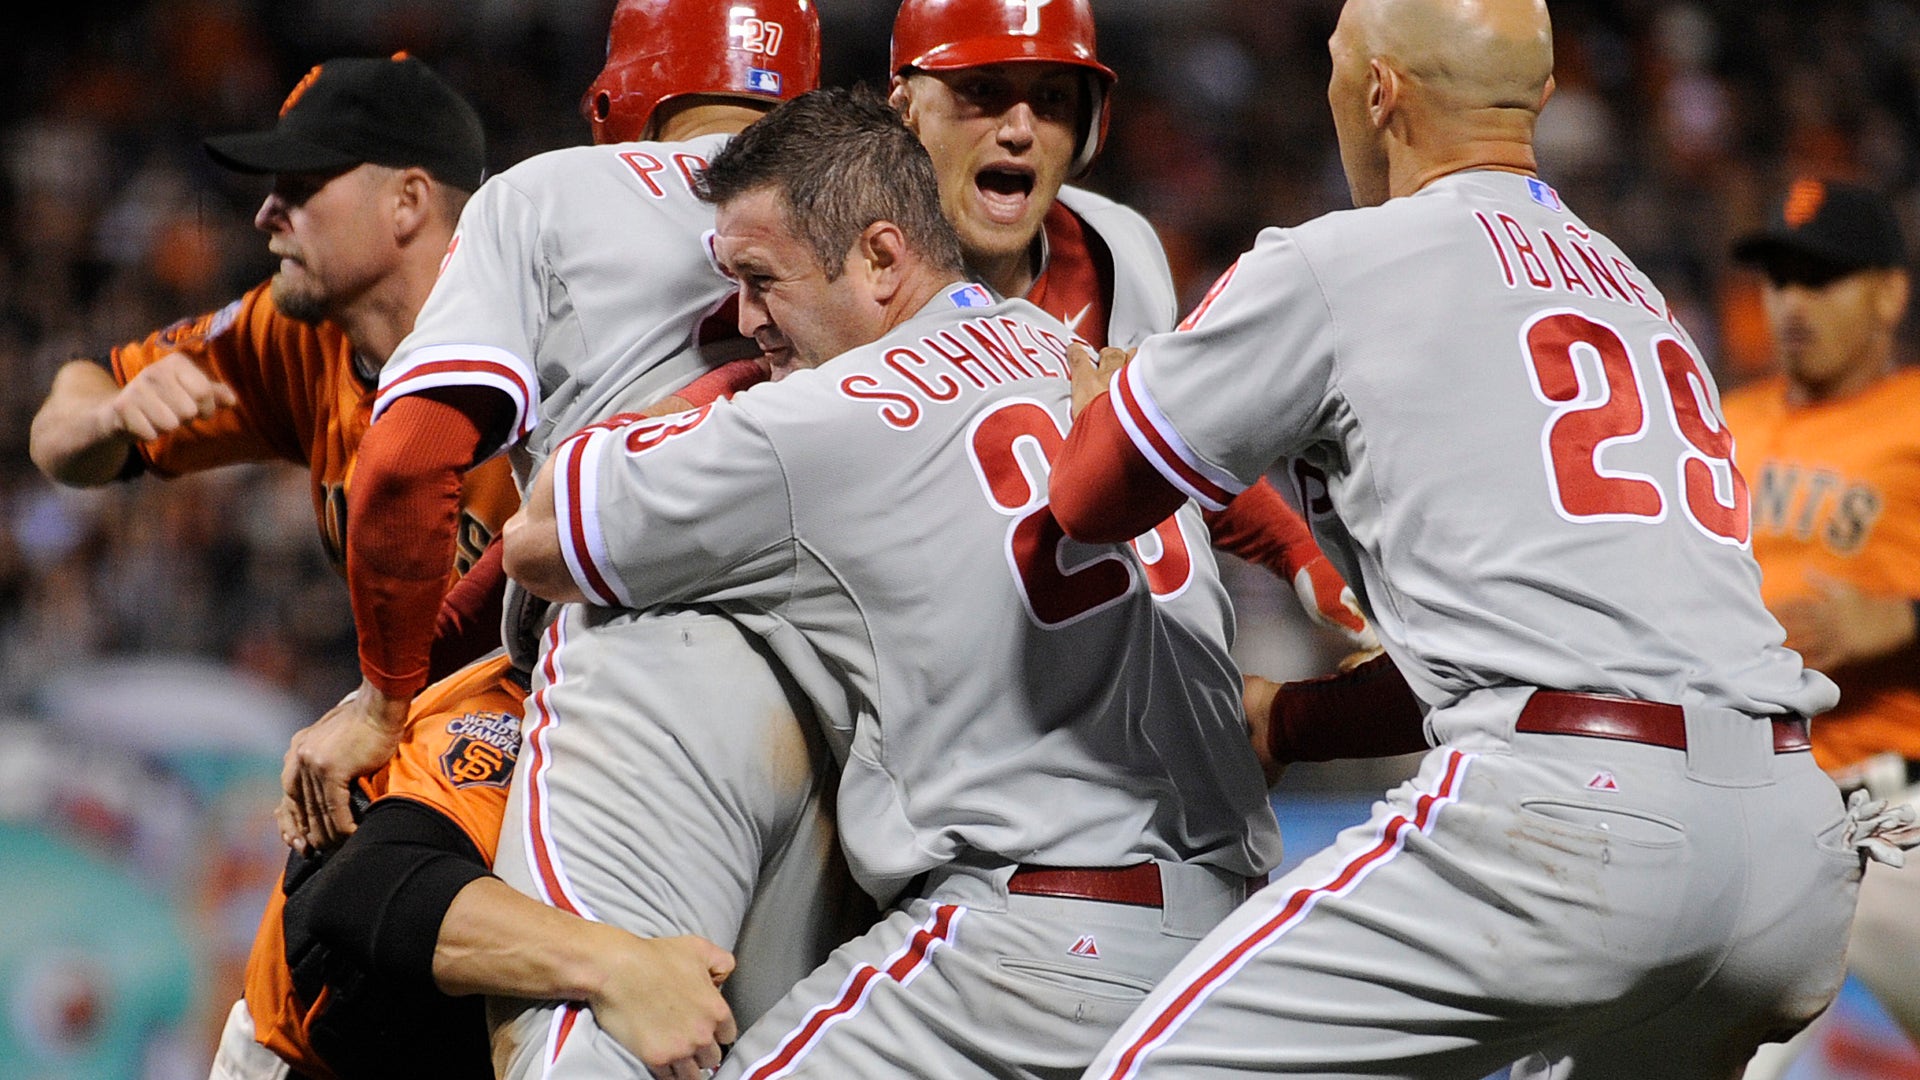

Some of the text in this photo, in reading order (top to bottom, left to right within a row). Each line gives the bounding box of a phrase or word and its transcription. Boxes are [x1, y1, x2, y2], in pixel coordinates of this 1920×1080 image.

[743, 18, 783, 56] 27
[1473, 210, 1688, 342] IBAÑE
[1518, 306, 1750, 551] 29
[1750, 460, 1884, 557] NTS
